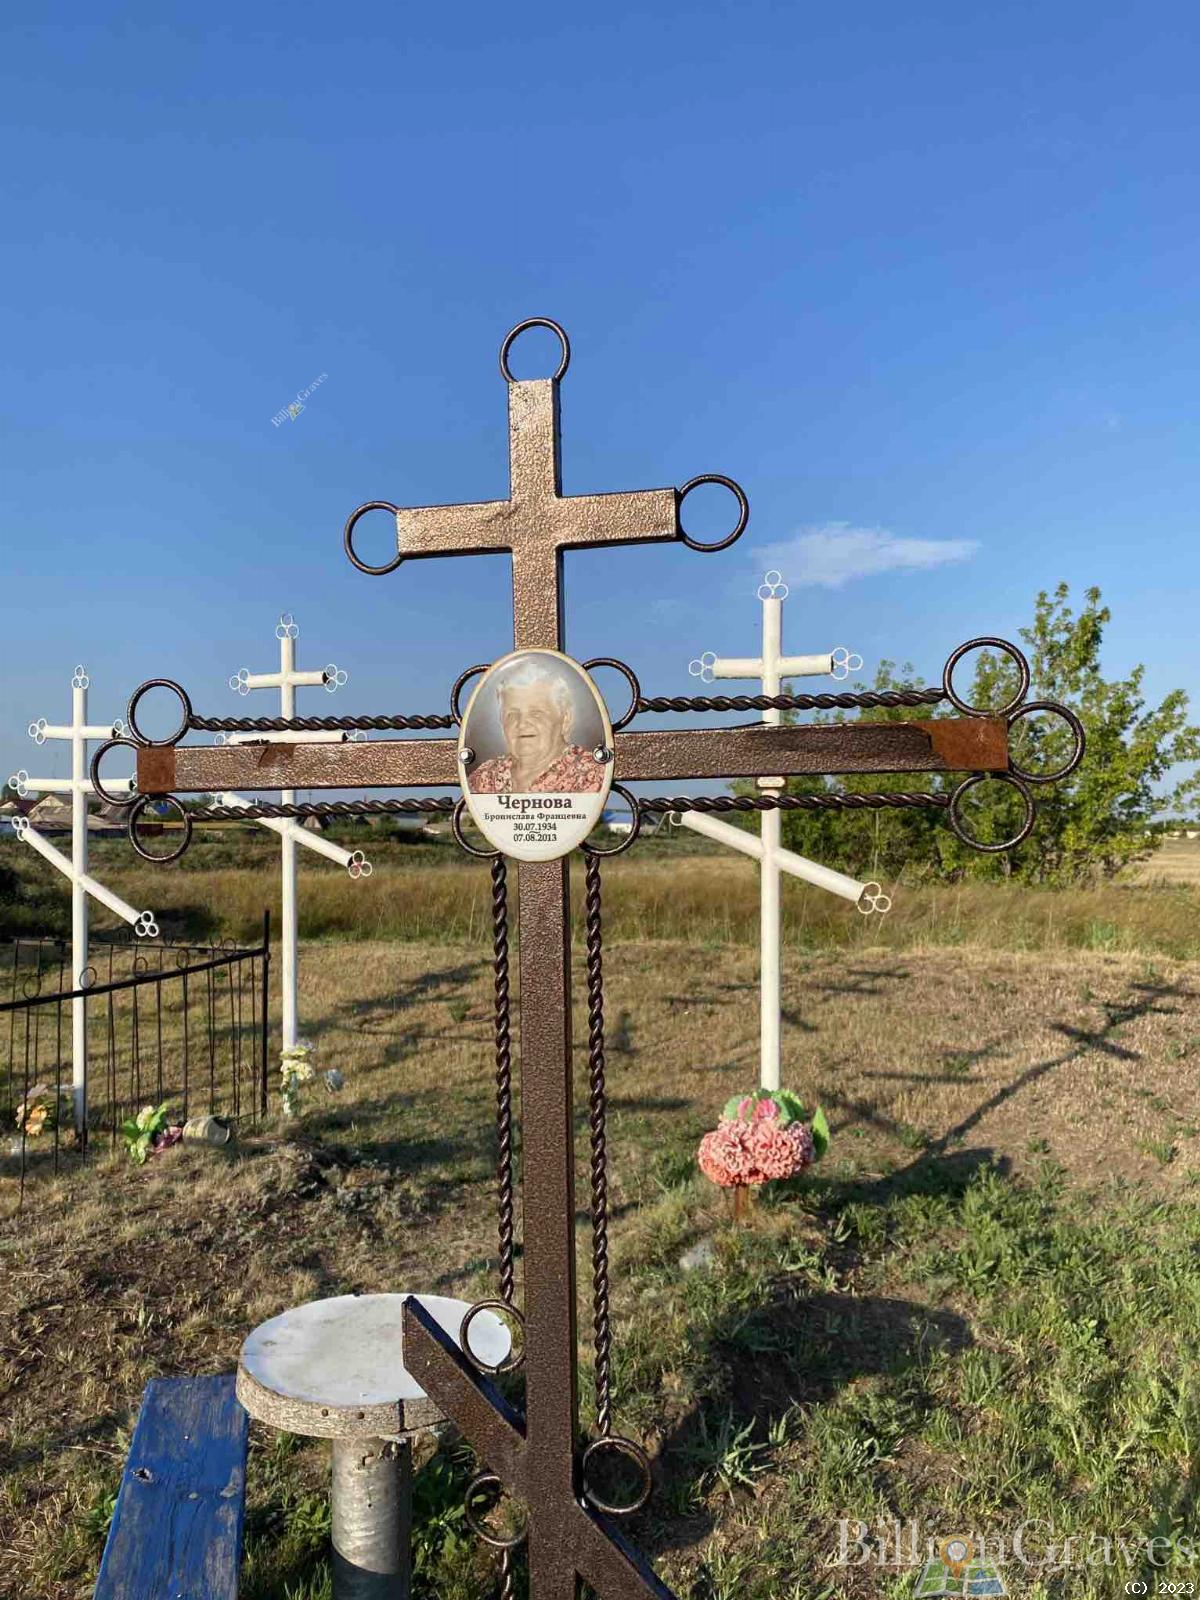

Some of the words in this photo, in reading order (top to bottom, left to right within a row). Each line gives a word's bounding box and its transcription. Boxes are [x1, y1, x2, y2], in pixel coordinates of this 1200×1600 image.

[497, 795, 572, 813] Чернова
[484, 813, 535, 821] Бронислава
[537, 813, 587, 821] Францевна
[513, 823, 557, 831] 30.07.1934
[513, 834, 557, 842] 07.08.2013
